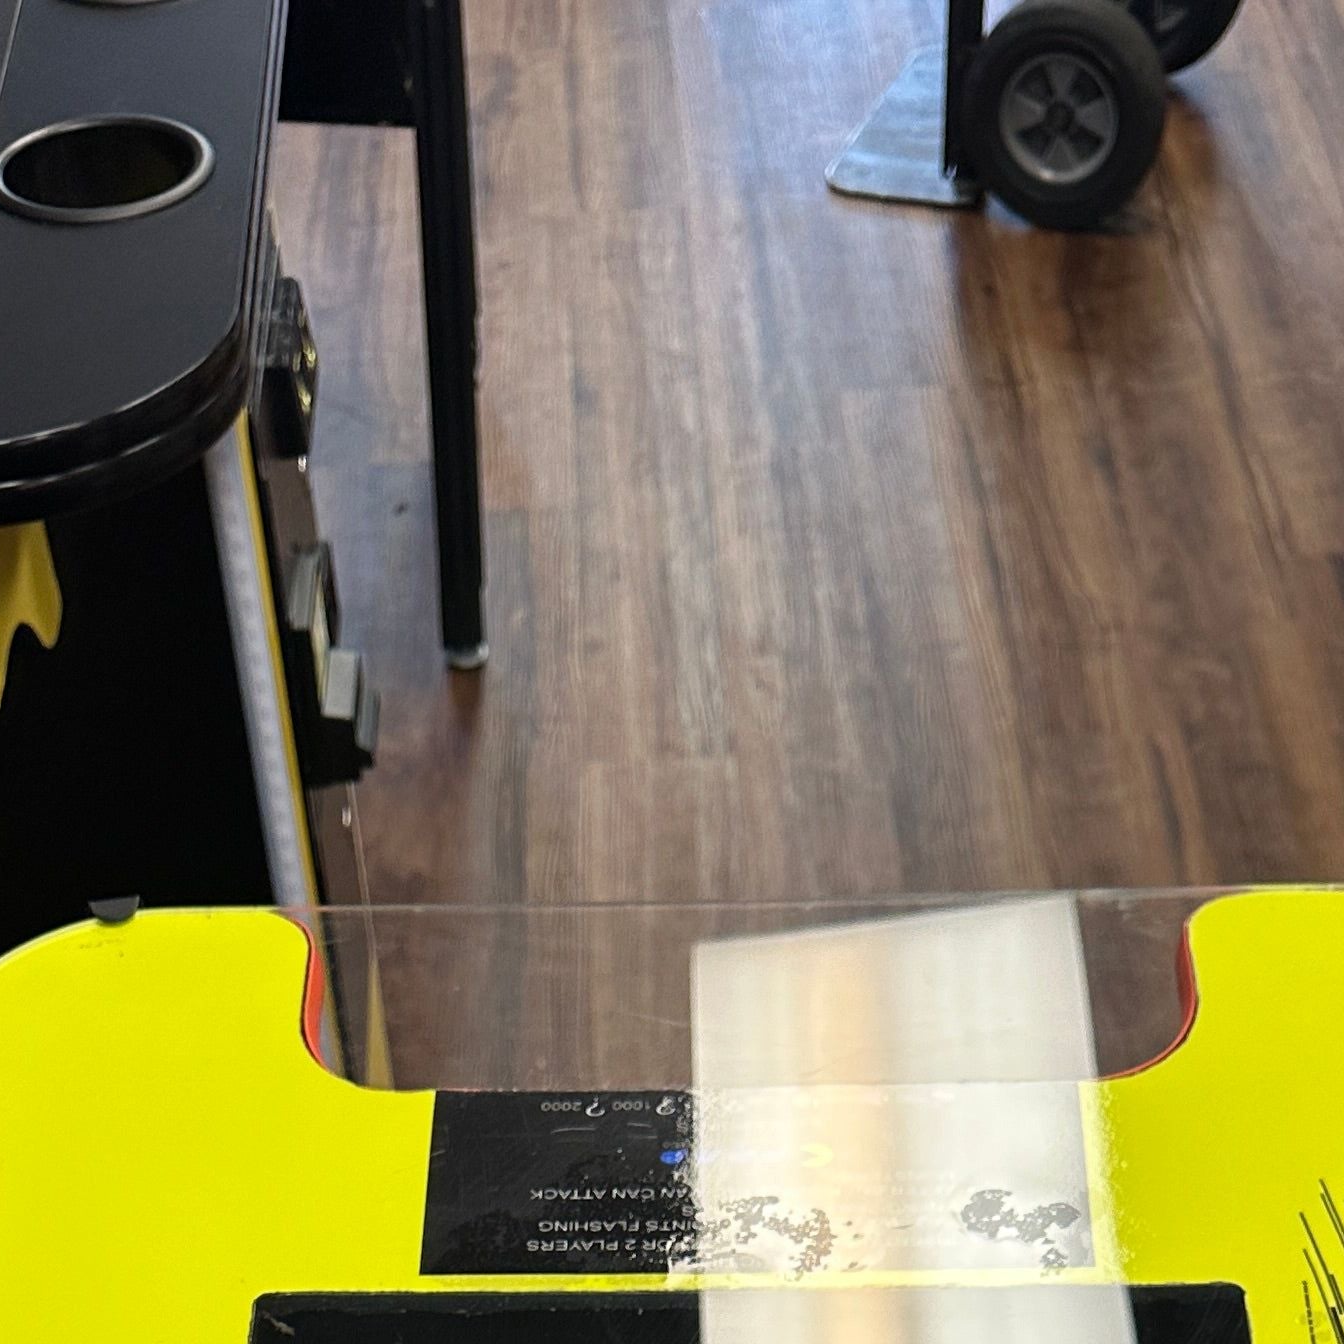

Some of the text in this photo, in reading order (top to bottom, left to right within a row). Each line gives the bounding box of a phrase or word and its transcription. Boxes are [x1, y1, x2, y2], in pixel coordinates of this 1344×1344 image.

[540, 1101, 582, 1112] 2000
[612, 1101, 651, 1111] 1000
[529, 1187, 607, 1201] ATTACK
[611, 1187, 655, 1201] CAN
[538, 1220, 640, 1233] FLASHING
[526, 1239, 619, 1252] PLAYERS
[624, 1240, 637, 1252] 2
